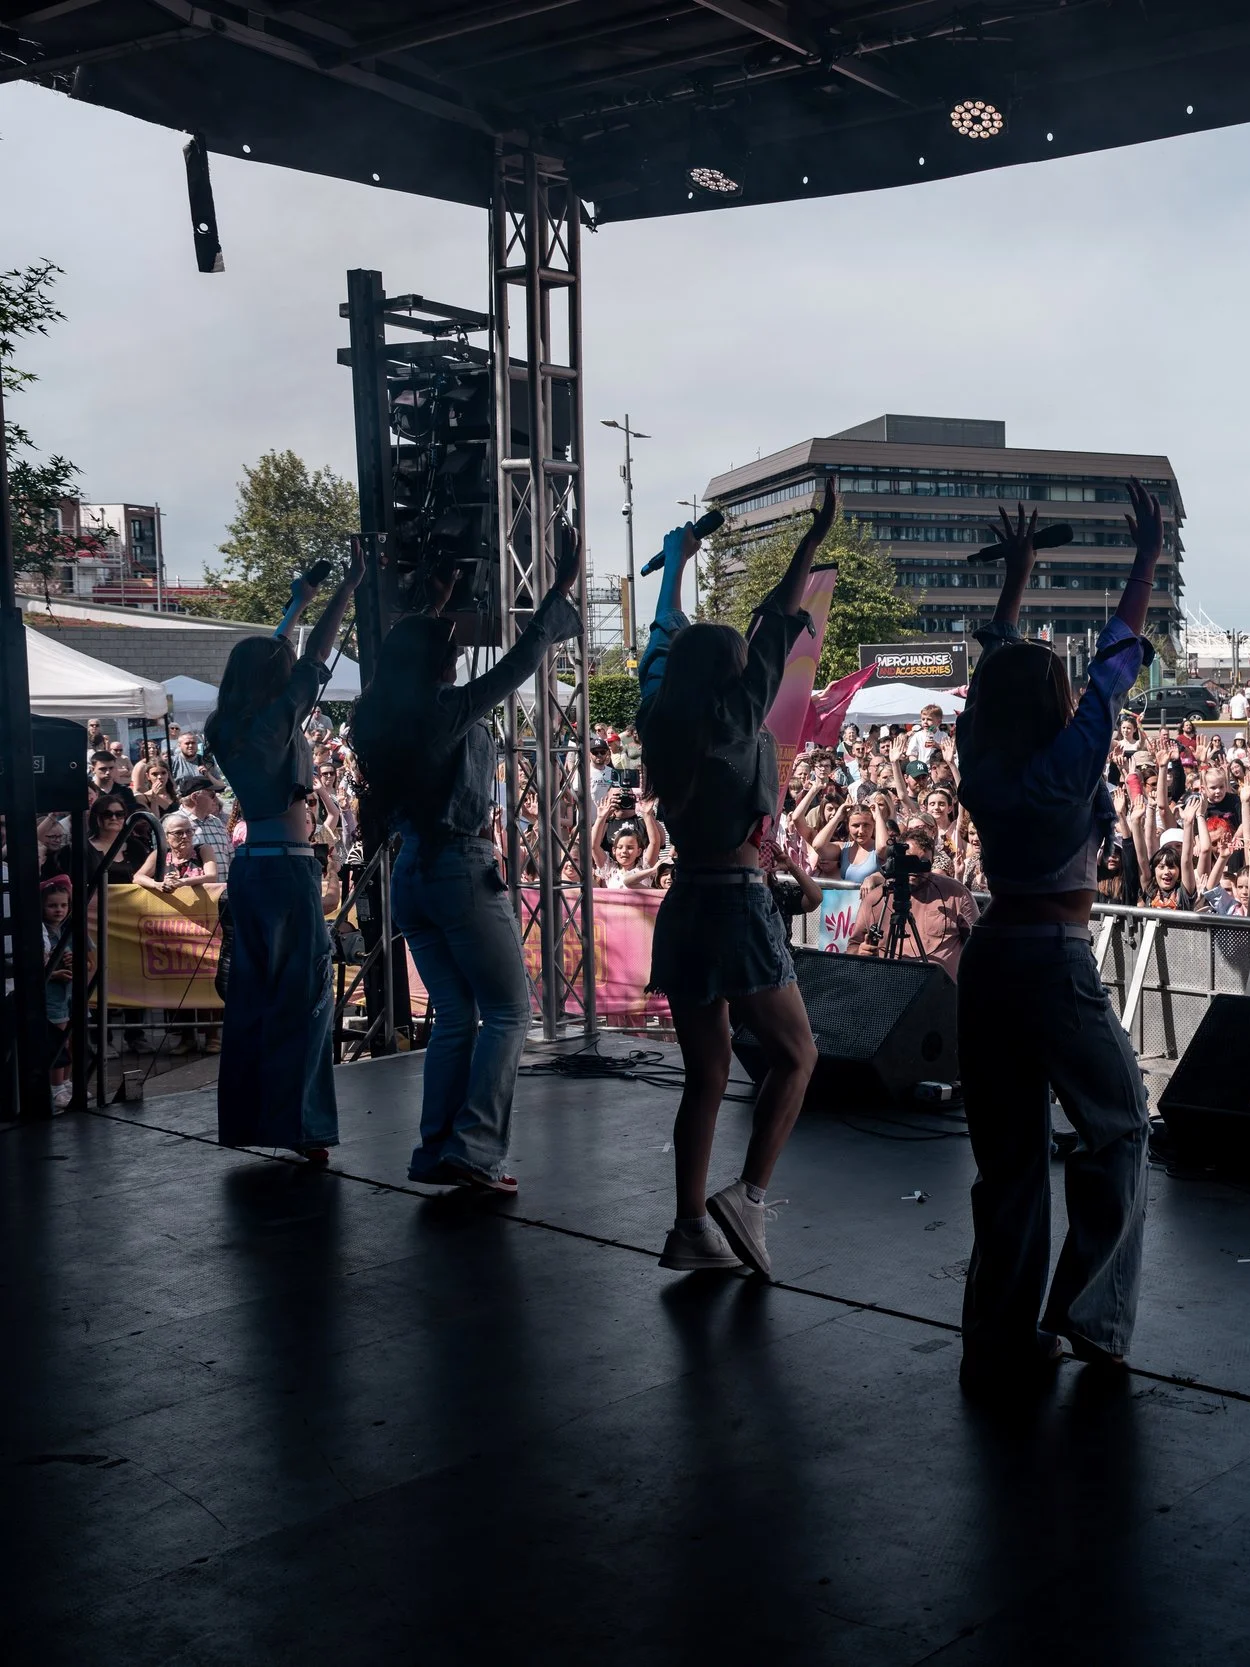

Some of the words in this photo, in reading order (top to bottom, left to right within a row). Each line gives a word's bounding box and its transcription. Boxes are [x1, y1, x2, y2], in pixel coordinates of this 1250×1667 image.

[878, 654, 951, 667] MERCHANDISE
[880, 666, 896, 676] AND
[895, 665, 951, 675] ACCESSORIES
